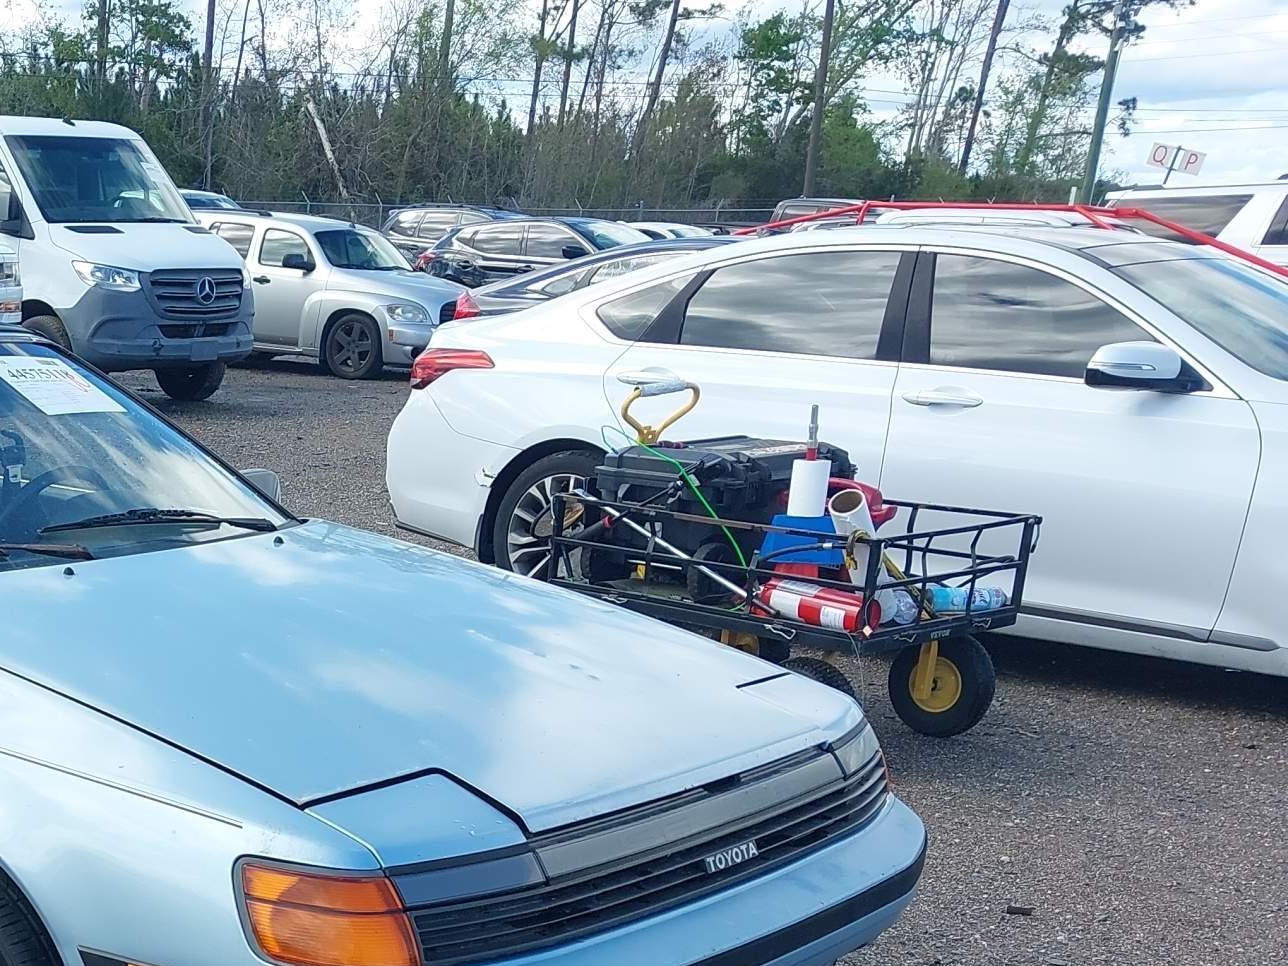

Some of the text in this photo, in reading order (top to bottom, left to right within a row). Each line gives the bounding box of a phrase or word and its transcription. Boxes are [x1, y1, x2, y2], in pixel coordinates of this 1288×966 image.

[1153, 145, 1168, 166] Q
[1184, 153, 1198, 170] P
[706, 842, 758, 872] TOYOTA
